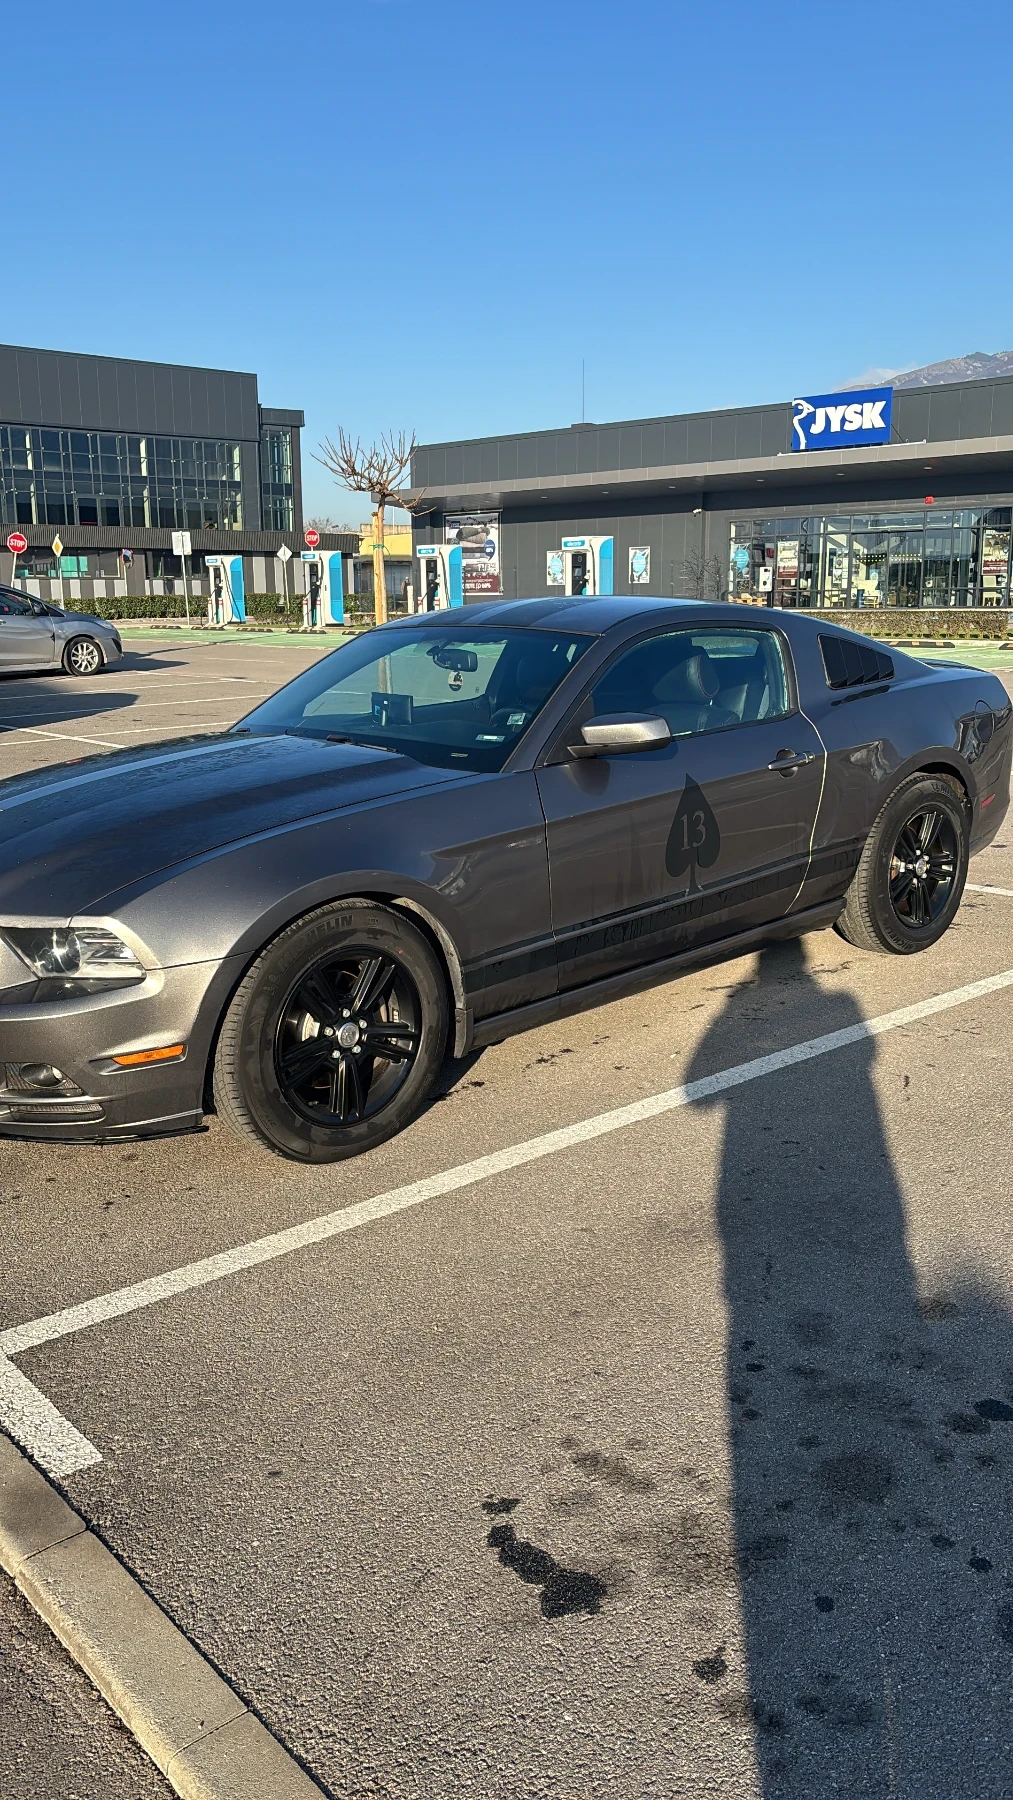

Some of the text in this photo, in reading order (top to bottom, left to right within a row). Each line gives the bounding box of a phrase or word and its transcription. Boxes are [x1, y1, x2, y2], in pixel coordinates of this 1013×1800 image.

[810, 400, 886, 434] JYSK
[9, 539, 25, 548] STOP
[681, 811, 706, 850] 13
